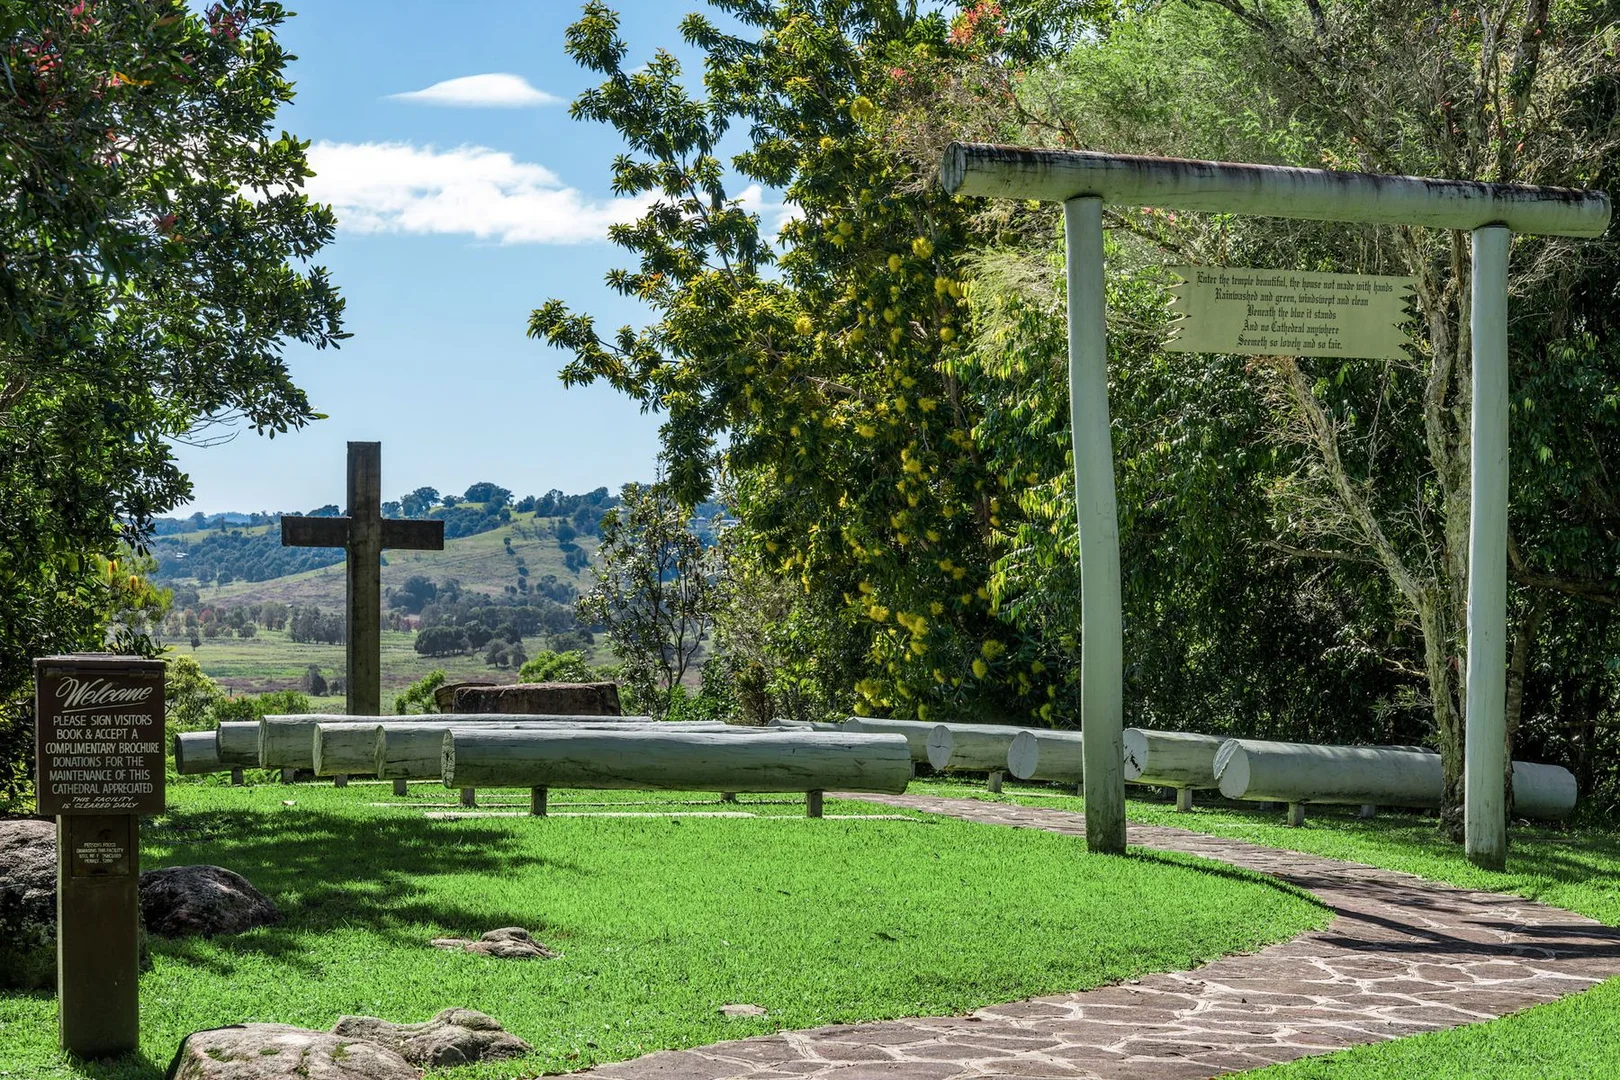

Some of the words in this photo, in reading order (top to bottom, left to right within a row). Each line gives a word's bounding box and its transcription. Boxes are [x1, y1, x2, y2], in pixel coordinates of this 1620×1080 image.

[1197, 272, 1216, 286] Enter
[1220, 274, 1230, 287] the
[1232, 275, 1254, 288] temple
[1256, 276, 1288, 288] beautiful,
[1290, 277, 1300, 290] the
[1302, 278, 1320, 290] house
[1324, 280, 1335, 289] not
[1337, 281, 1354, 290] made
[1356, 282, 1371, 294] with
[1374, 282, 1393, 294] hands
[1214, 288, 1258, 304] Rainwashed
[1260, 292, 1273, 302] and
[1276, 294, 1296, 305] green,
[1298, 294, 1335, 307] windswept
[1337, 296, 1350, 305] and
[1352, 296, 1368, 306] clean
[1246, 303, 1276, 320] Beneath
[1278, 307, 1288, 320] the
[1290, 307, 1304, 318] blue
[1306, 308, 1312, 318] it
[1314, 310, 1336, 320] stands
[1242, 319, 1258, 334] And
[1271, 321, 1304, 335] Cathedral
[1306, 324, 1340, 336] anywhere
[1236, 333, 1268, 349] Seemeth
[1280, 336, 1300, 350] lovely
[1303, 338, 1316, 348] and
[1318, 341, 1326, 349] so
[1328, 338, 1342, 350] fair.
[56, 677, 152, 708] Welcome
[54, 715, 86, 726] PLEASE
[91, 715, 111, 725] SIGN
[114, 714, 152, 726] VISITORS
[57, 729, 82, 740] BOOK
[86, 729, 92, 740] &
[95, 729, 128, 739] ACCEPT
[132, 728, 138, 739] A
[46, 742, 116, 754] COMPLIMENTARY
[119, 742, 159, 754] BROCHURE
[53, 757, 101, 767] DONATIONS
[106, 756, 123, 766] FOR
[126, 756, 144, 766] THE
[50, 770, 112, 780] MAINTENANCE
[115, 770, 126, 780] OF
[128, 770, 150, 780] THIS
[52, 784, 99, 794] CATHEDRAL
[102, 783, 152, 794] APPRECIATED
